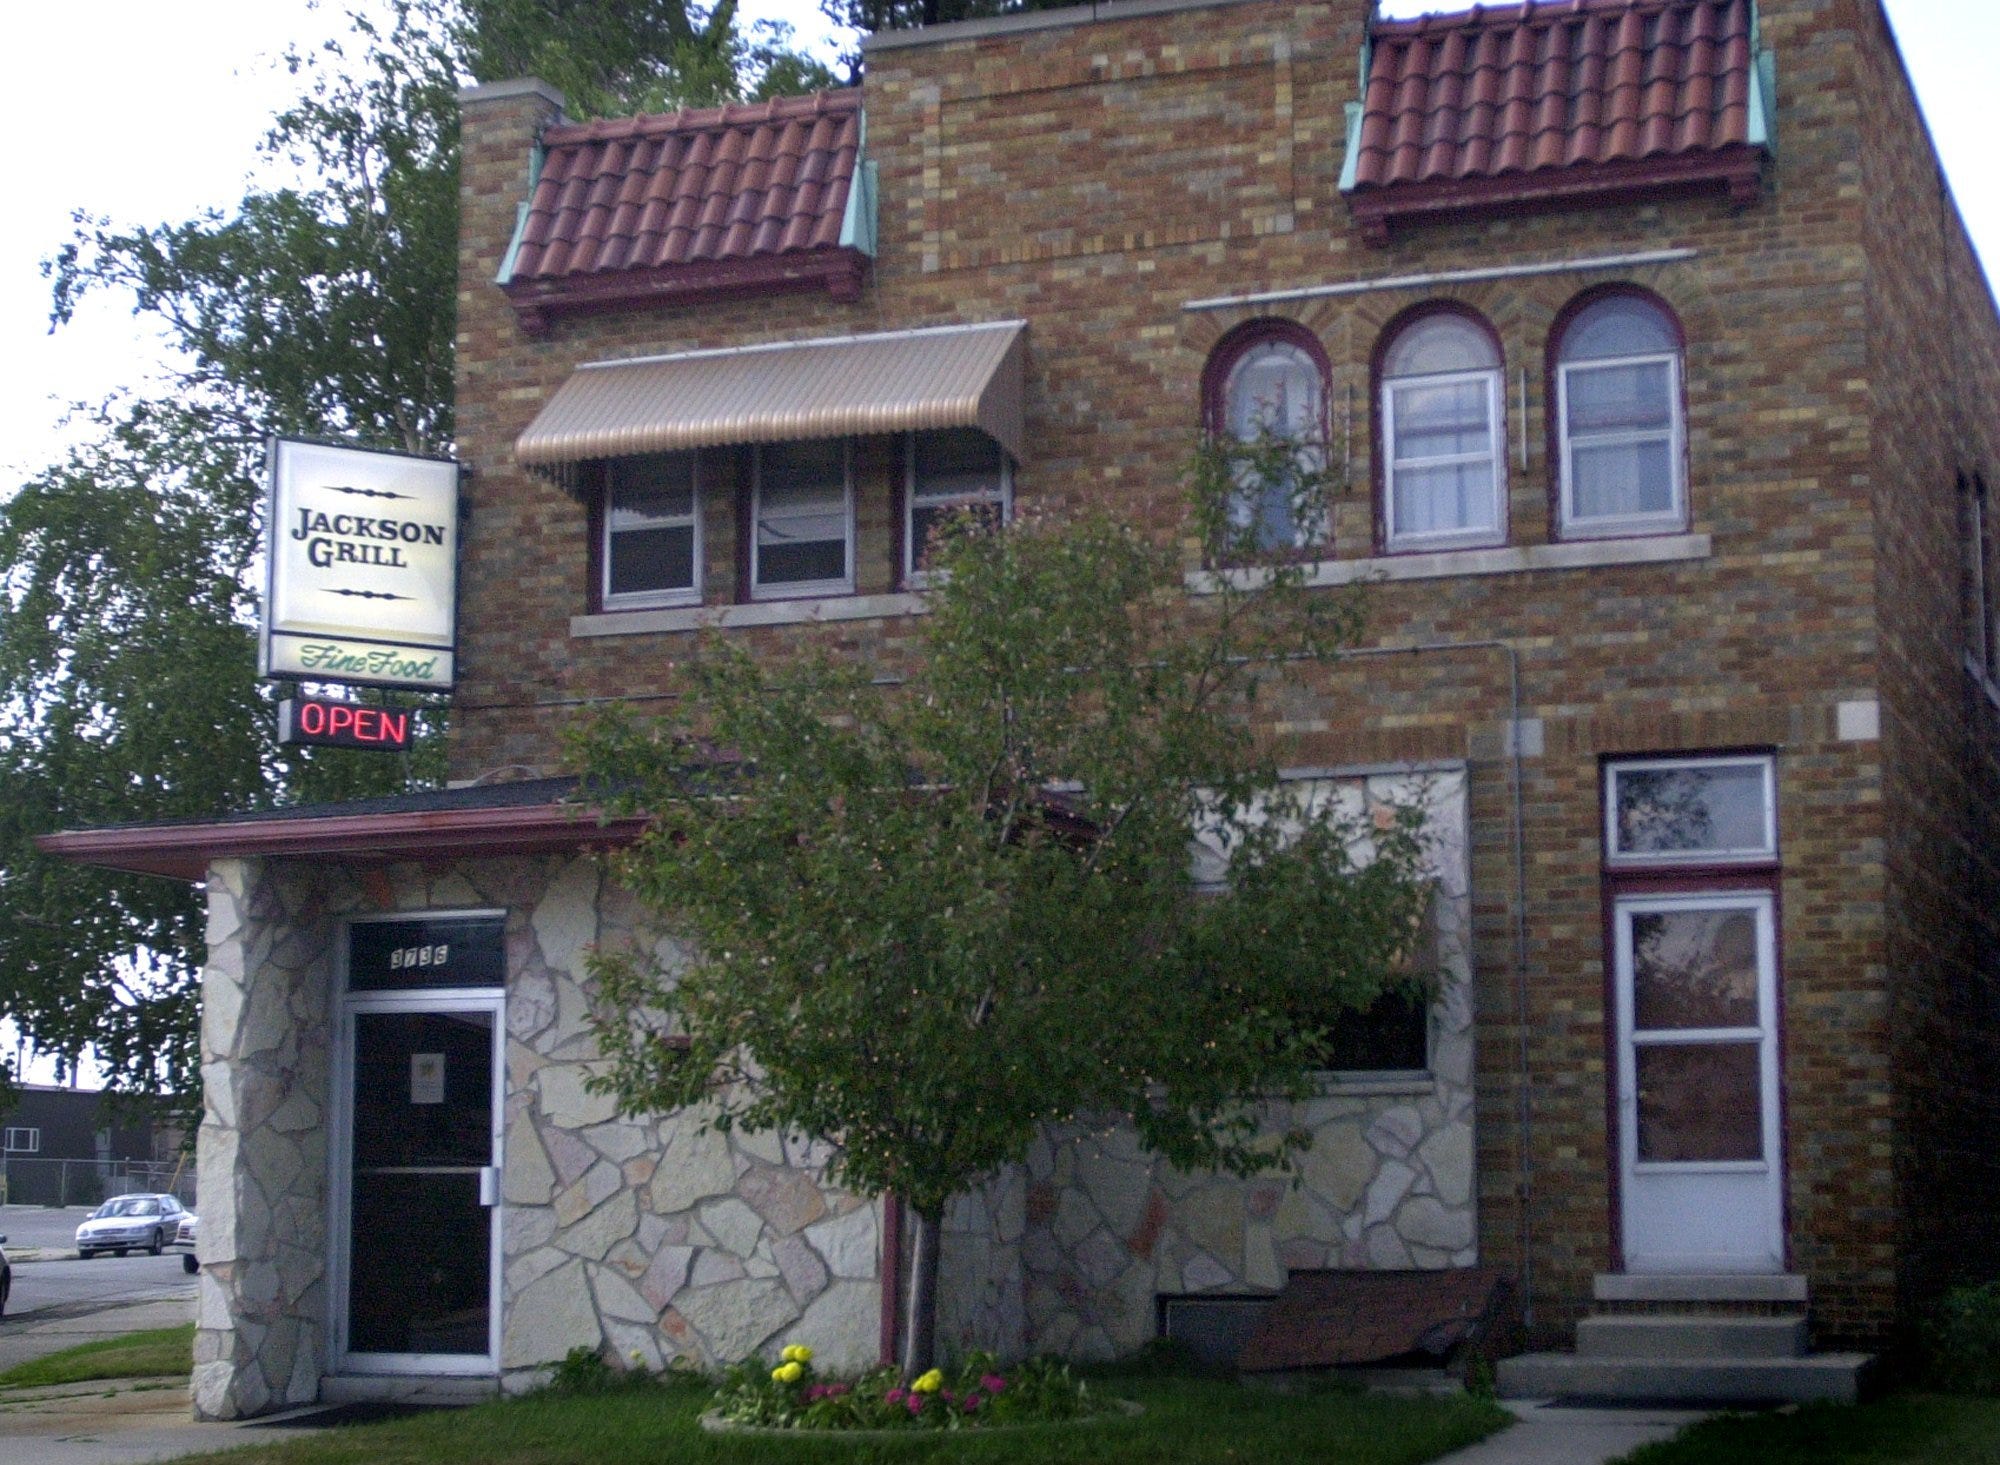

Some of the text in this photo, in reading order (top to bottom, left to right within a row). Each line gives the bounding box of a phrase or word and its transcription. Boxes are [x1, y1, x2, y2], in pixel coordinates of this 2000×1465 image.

[292, 507, 446, 545] JACKSON
[307, 538, 407, 568] GRILL
[301, 644, 436, 679] Fine Food
[301, 703, 405, 743] OPEN
